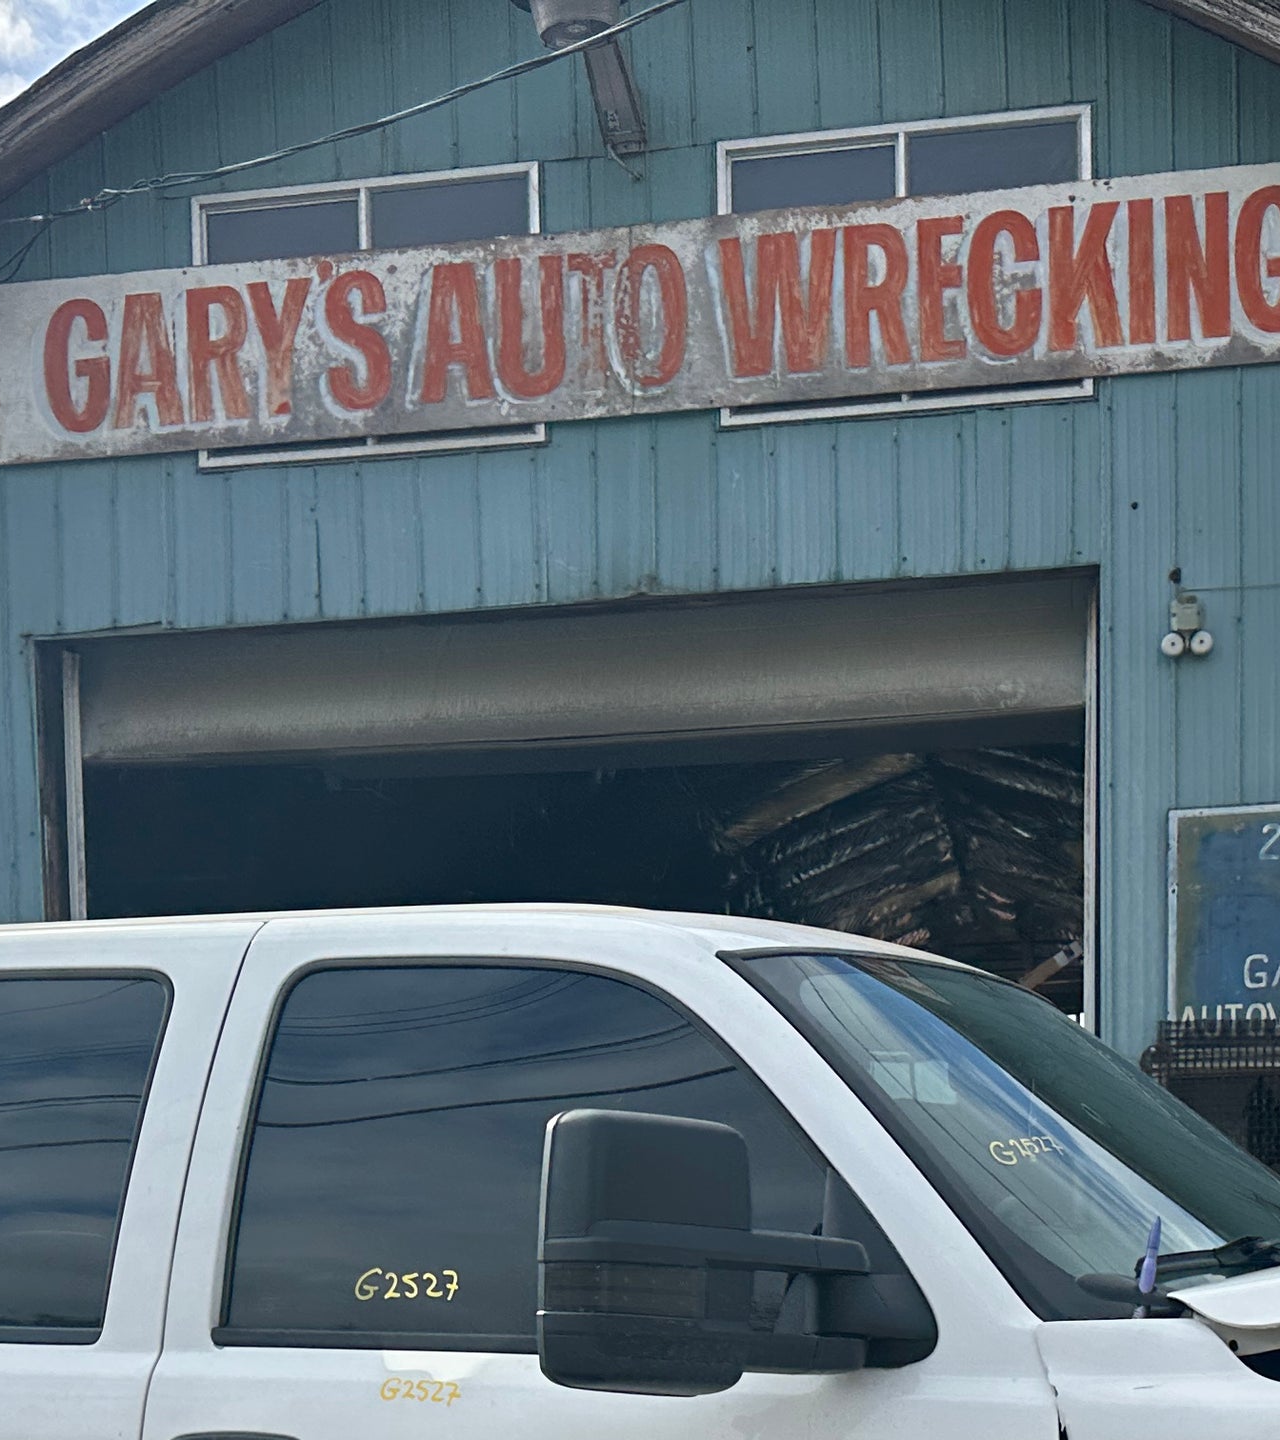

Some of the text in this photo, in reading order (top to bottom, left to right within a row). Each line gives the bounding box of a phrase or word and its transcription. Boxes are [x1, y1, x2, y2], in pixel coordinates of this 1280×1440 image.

[43, 259, 393, 433] GARY'S
[419, 243, 687, 404] AUTO
[354, 1267, 459, 1301] G2527
[380, 1377, 462, 1408] G2527
